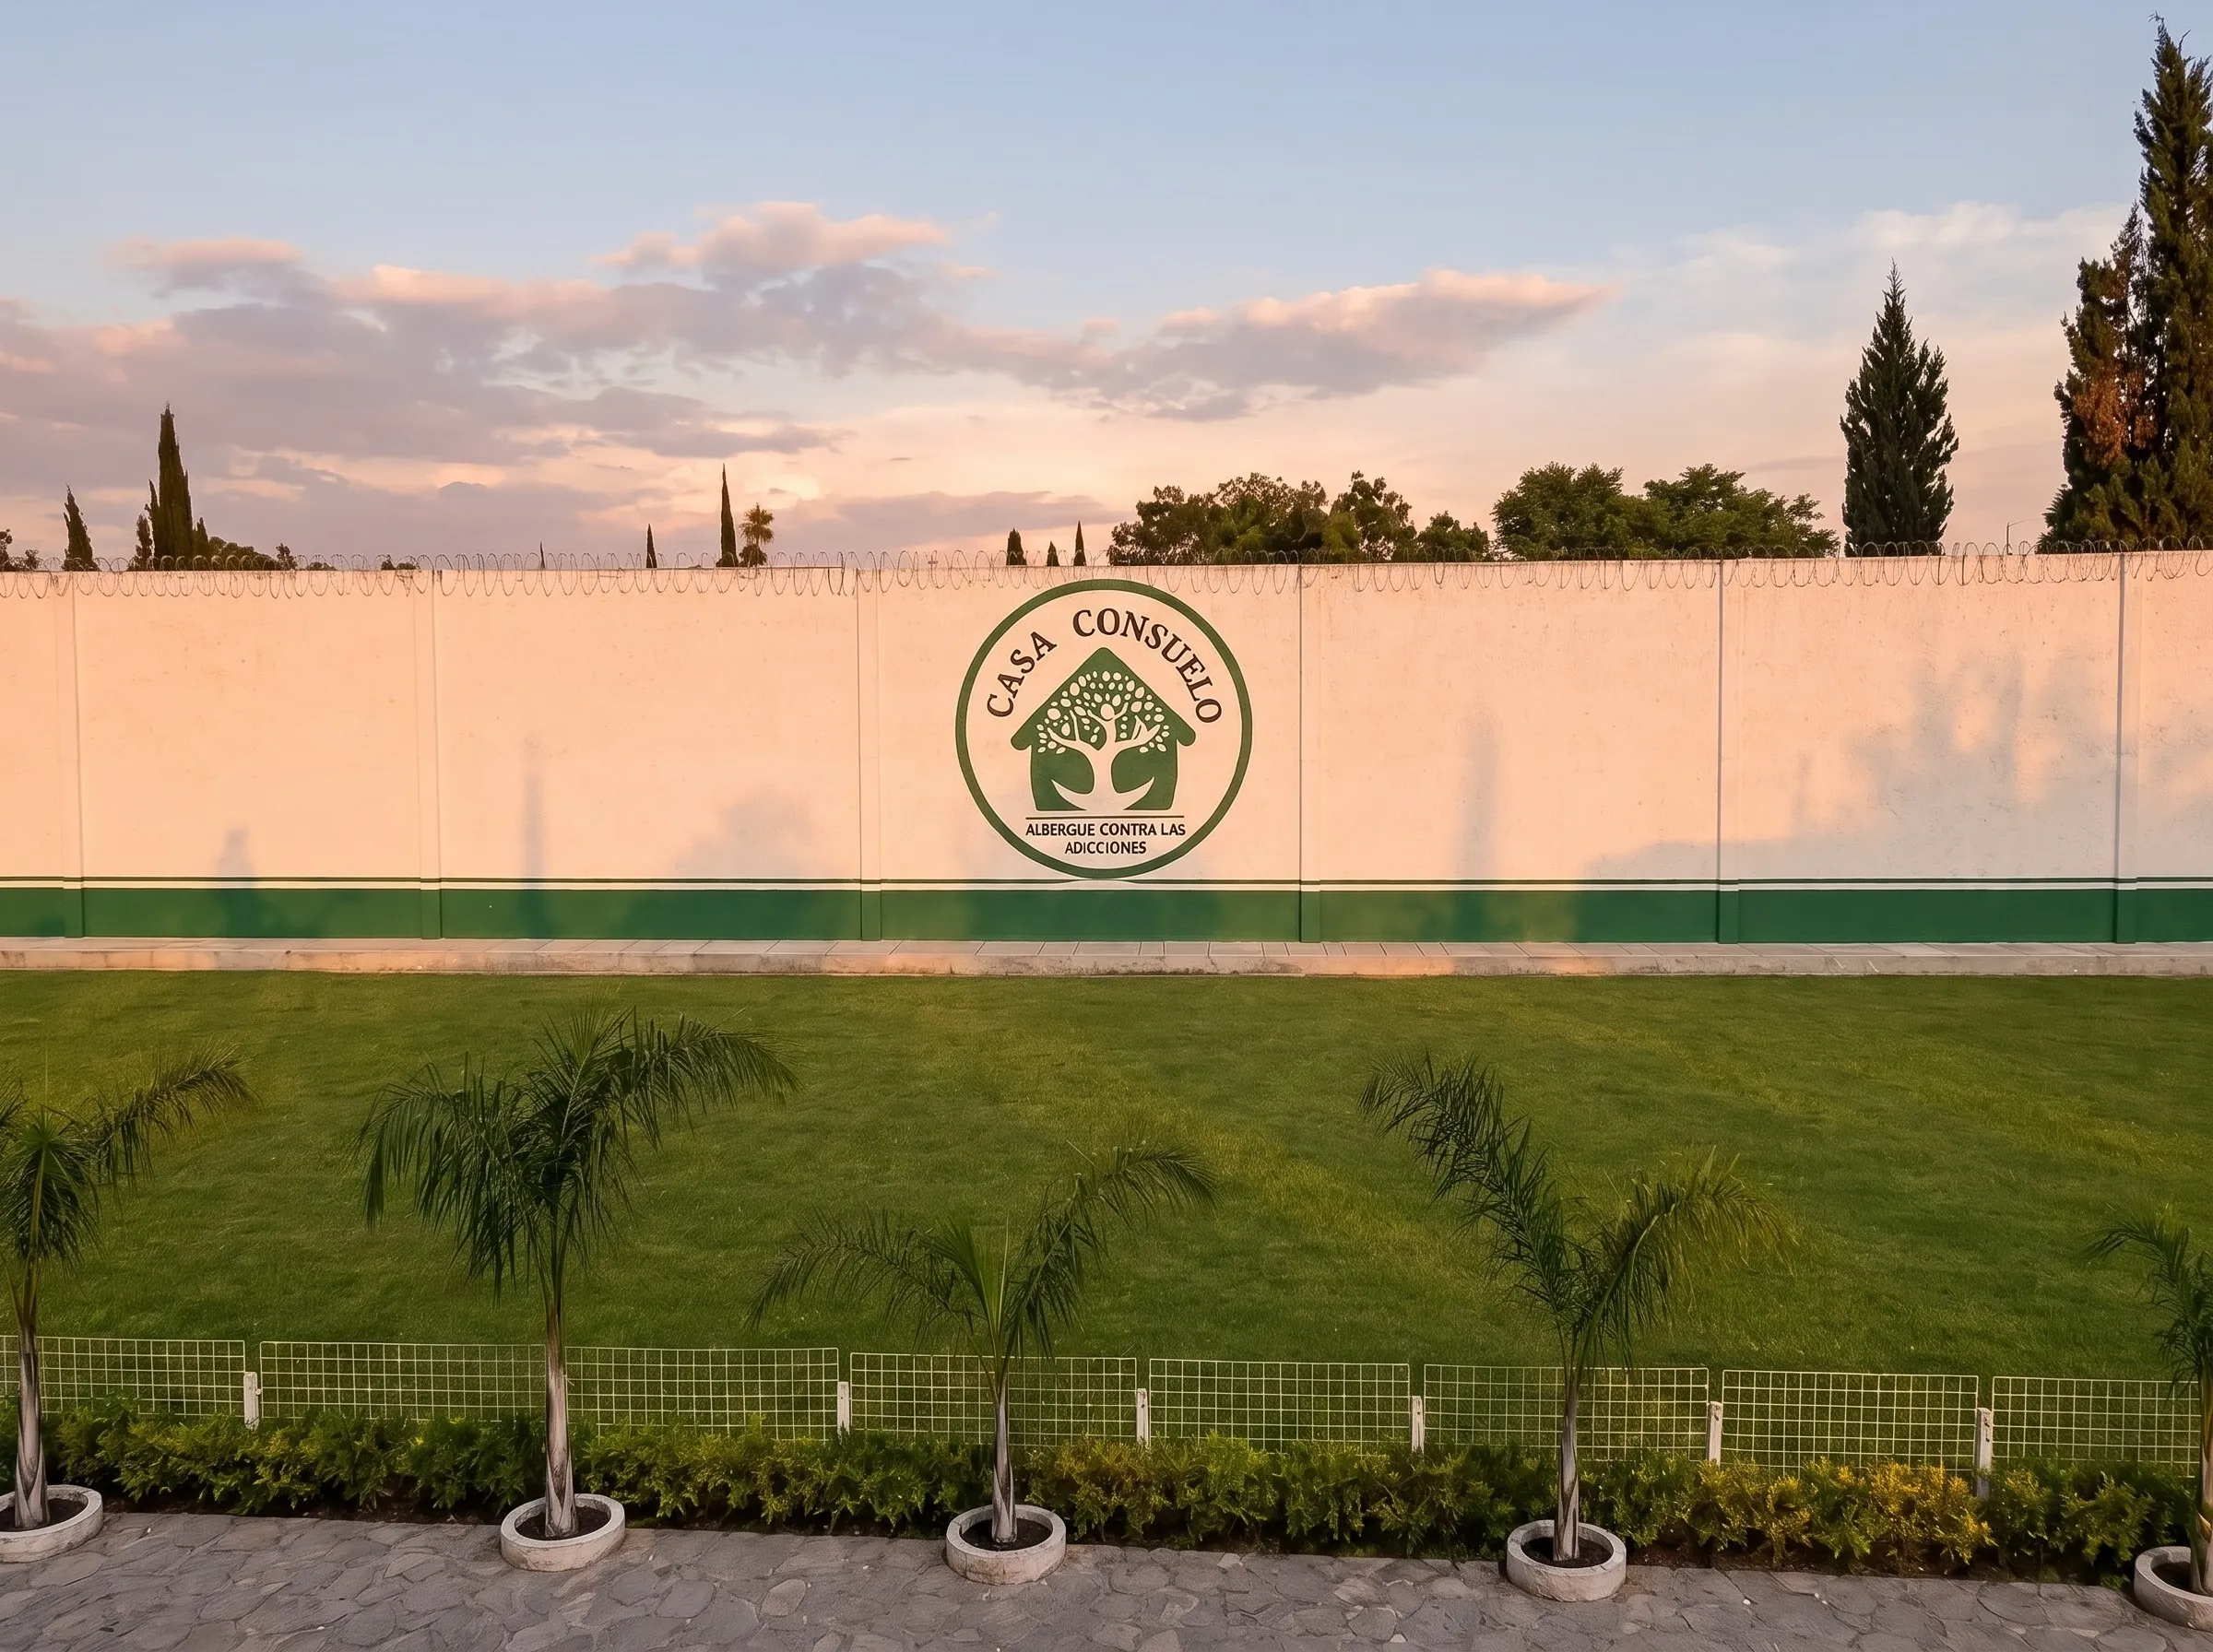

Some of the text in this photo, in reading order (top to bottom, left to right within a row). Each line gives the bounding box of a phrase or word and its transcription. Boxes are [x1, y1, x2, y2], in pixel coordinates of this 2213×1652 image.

[987, 608, 1223, 724] CASA CONSUELO
[1024, 822, 1187, 837] ALBERGUE CONTRA LAS
[1064, 841, 1147, 855] ADICCIONES
